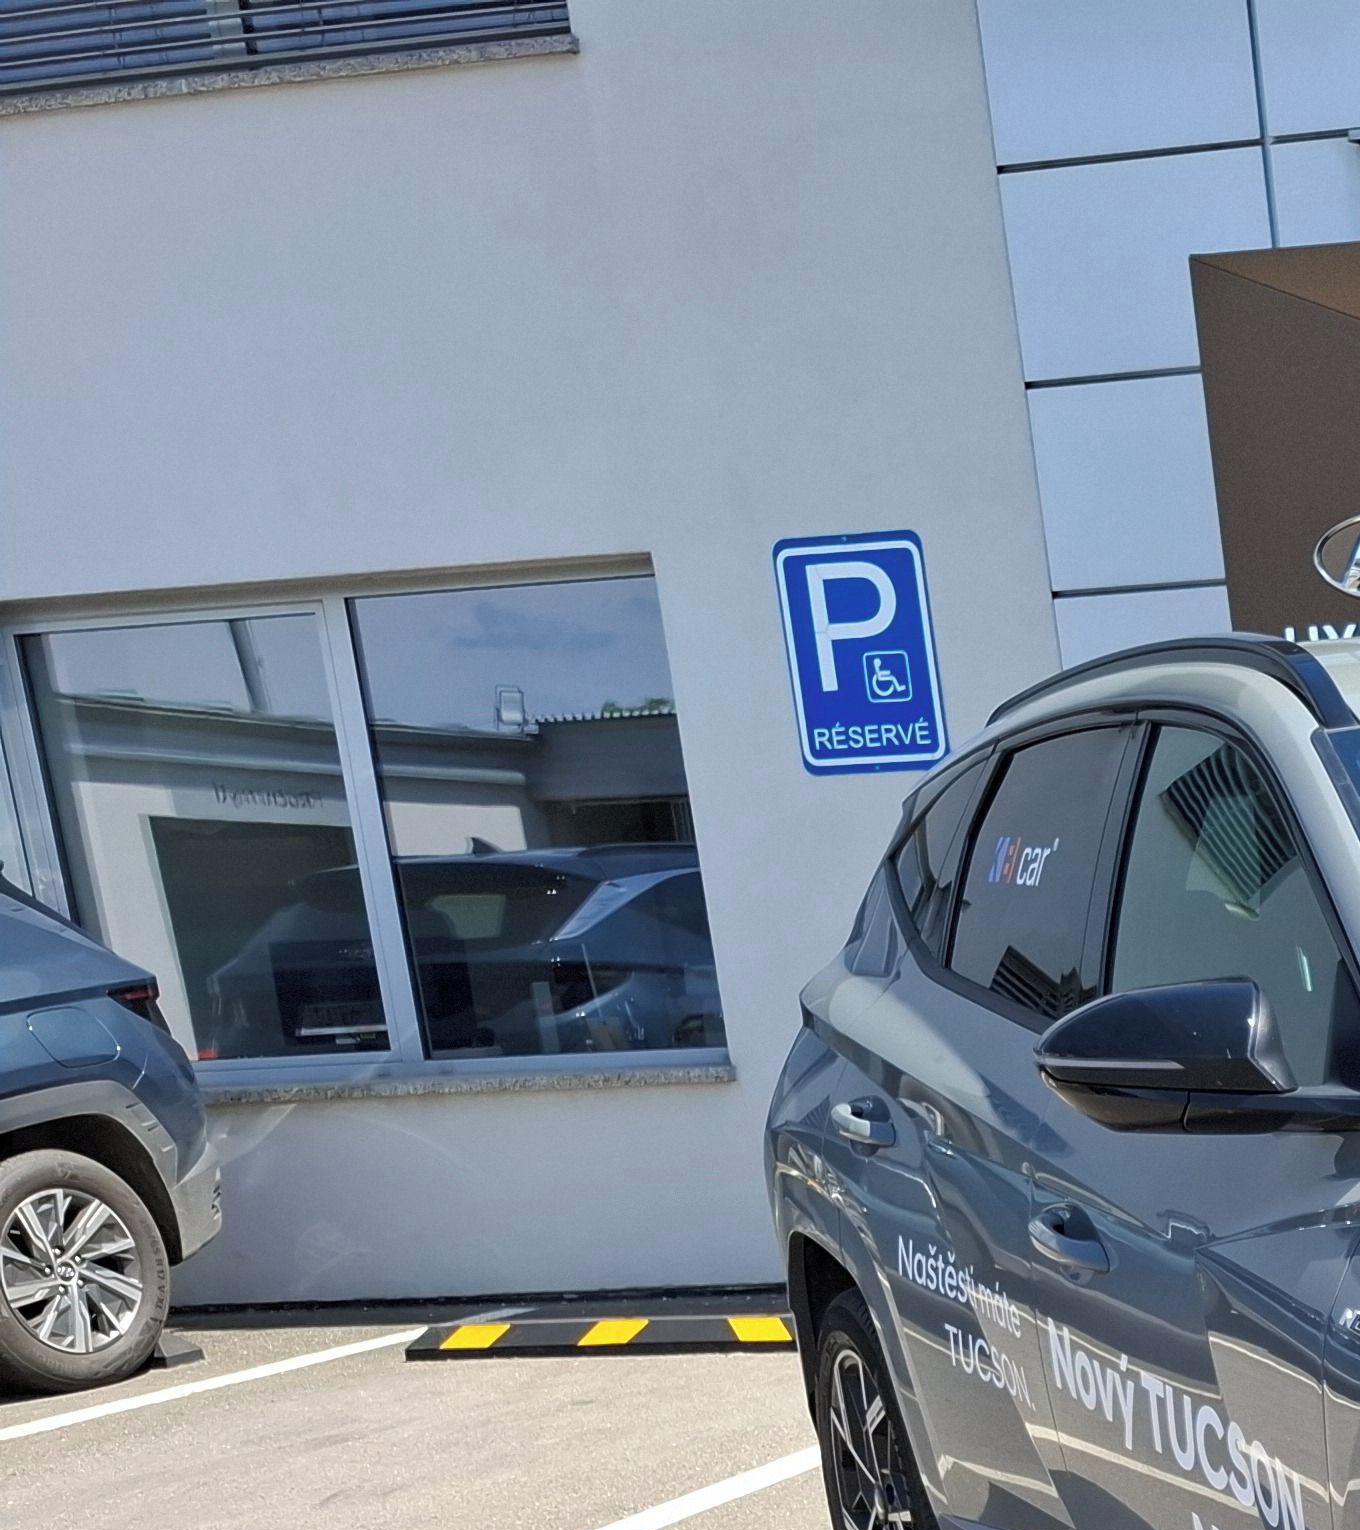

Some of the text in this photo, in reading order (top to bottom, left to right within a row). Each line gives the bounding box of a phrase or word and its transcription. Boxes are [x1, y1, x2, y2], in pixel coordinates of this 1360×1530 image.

[805, 561, 897, 692] P
[813, 717, 932, 751] RÉSERVÉ
[1047, 1316, 1135, 1451] Nový
